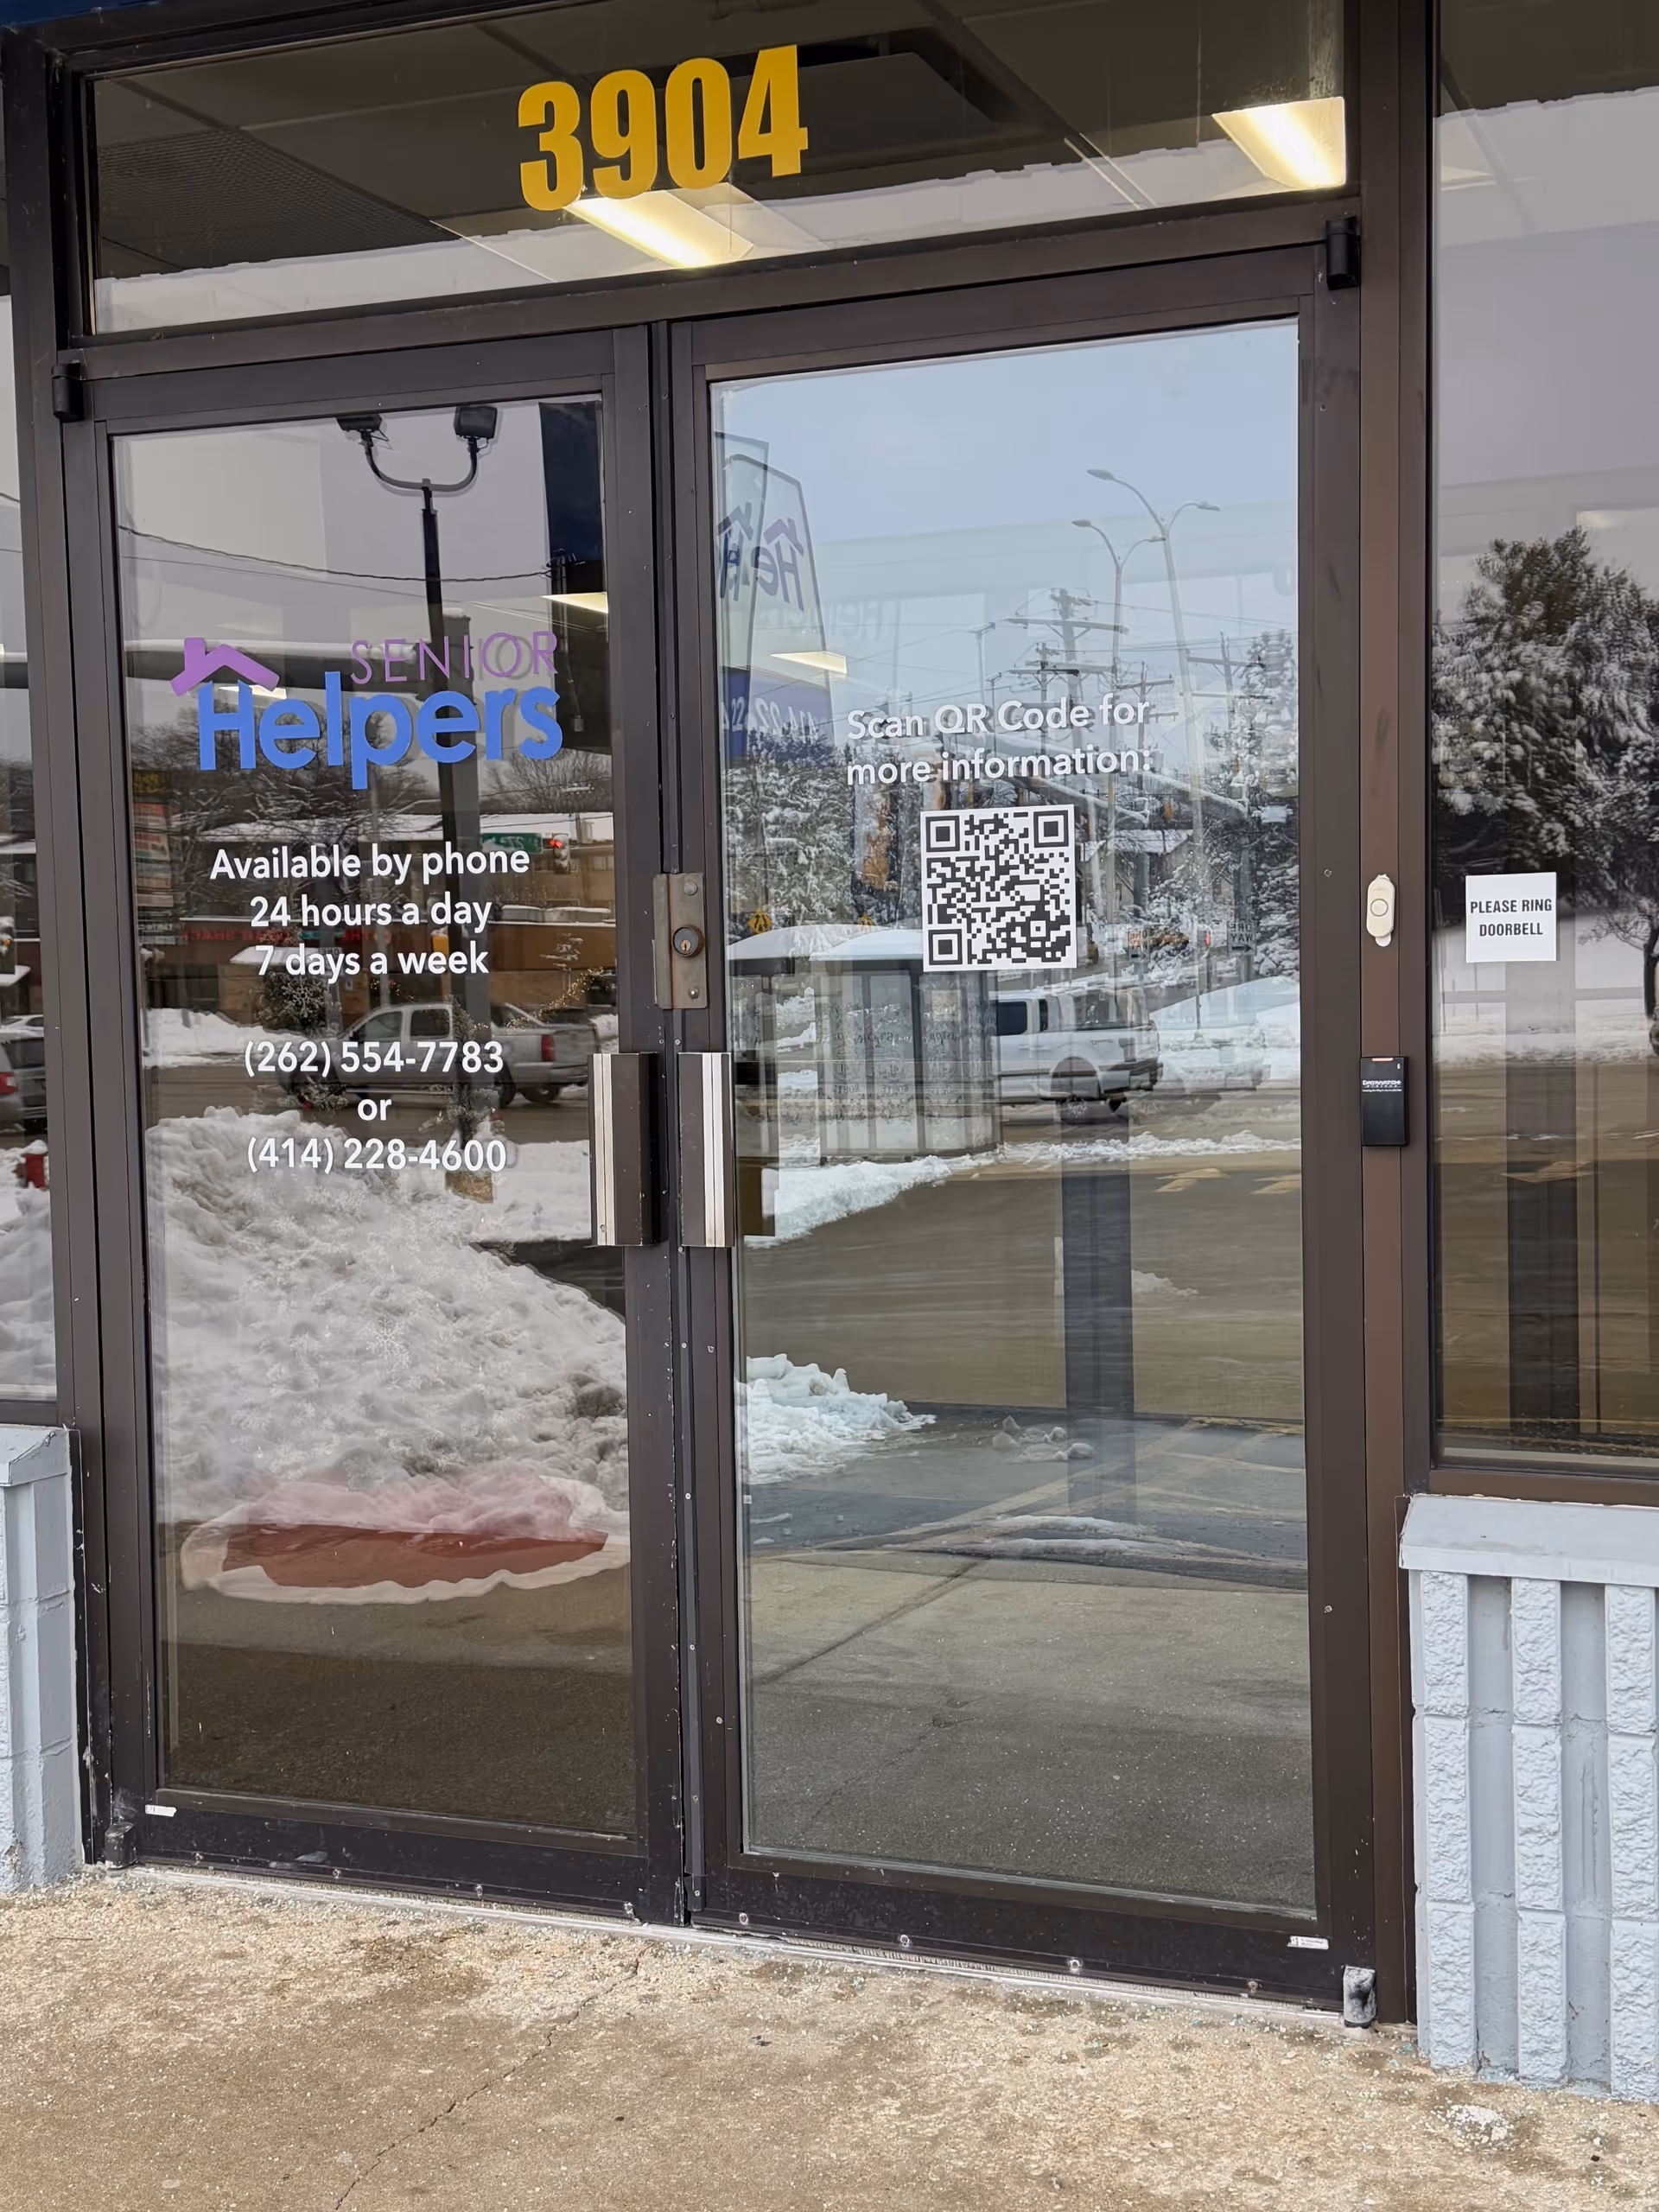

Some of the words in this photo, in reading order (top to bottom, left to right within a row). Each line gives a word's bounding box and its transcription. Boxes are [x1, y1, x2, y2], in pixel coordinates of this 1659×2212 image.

[518, 44, 808, 212] 3904
[351, 630, 558, 684] SENIOR
[197, 671, 563, 790] Helpers
[847, 705, 924, 741] Scan
[933, 703, 988, 736] QR
[998, 696, 1090, 731] Code
[1100, 690, 1150, 725] for
[847, 757, 931, 785] more
[942, 744, 1152, 782] information:
[210, 845, 360, 880] Available
[372, 845, 411, 883] by
[422, 842, 531, 883] phone
[250, 896, 292, 927] 24
[301, 894, 391, 926] hours
[402, 903, 421, 925] a
[429, 891, 493, 931] day
[1471, 899, 1517, 913] PLEASE
[1521, 898, 1553, 912] RING
[1479, 922, 1543, 937] DOORBELL
[255, 945, 274, 976] 7
[285, 943, 359, 983] days
[370, 954, 388, 976] a
[398, 942, 489, 974] week
[244, 1042, 331, 1077] (262)
[340, 1039, 504, 1074] 554-7783
[357, 1099, 391, 1121] or
[247, 1137, 334, 1175] (414)
[344, 1138, 506, 1172] 228-4600
